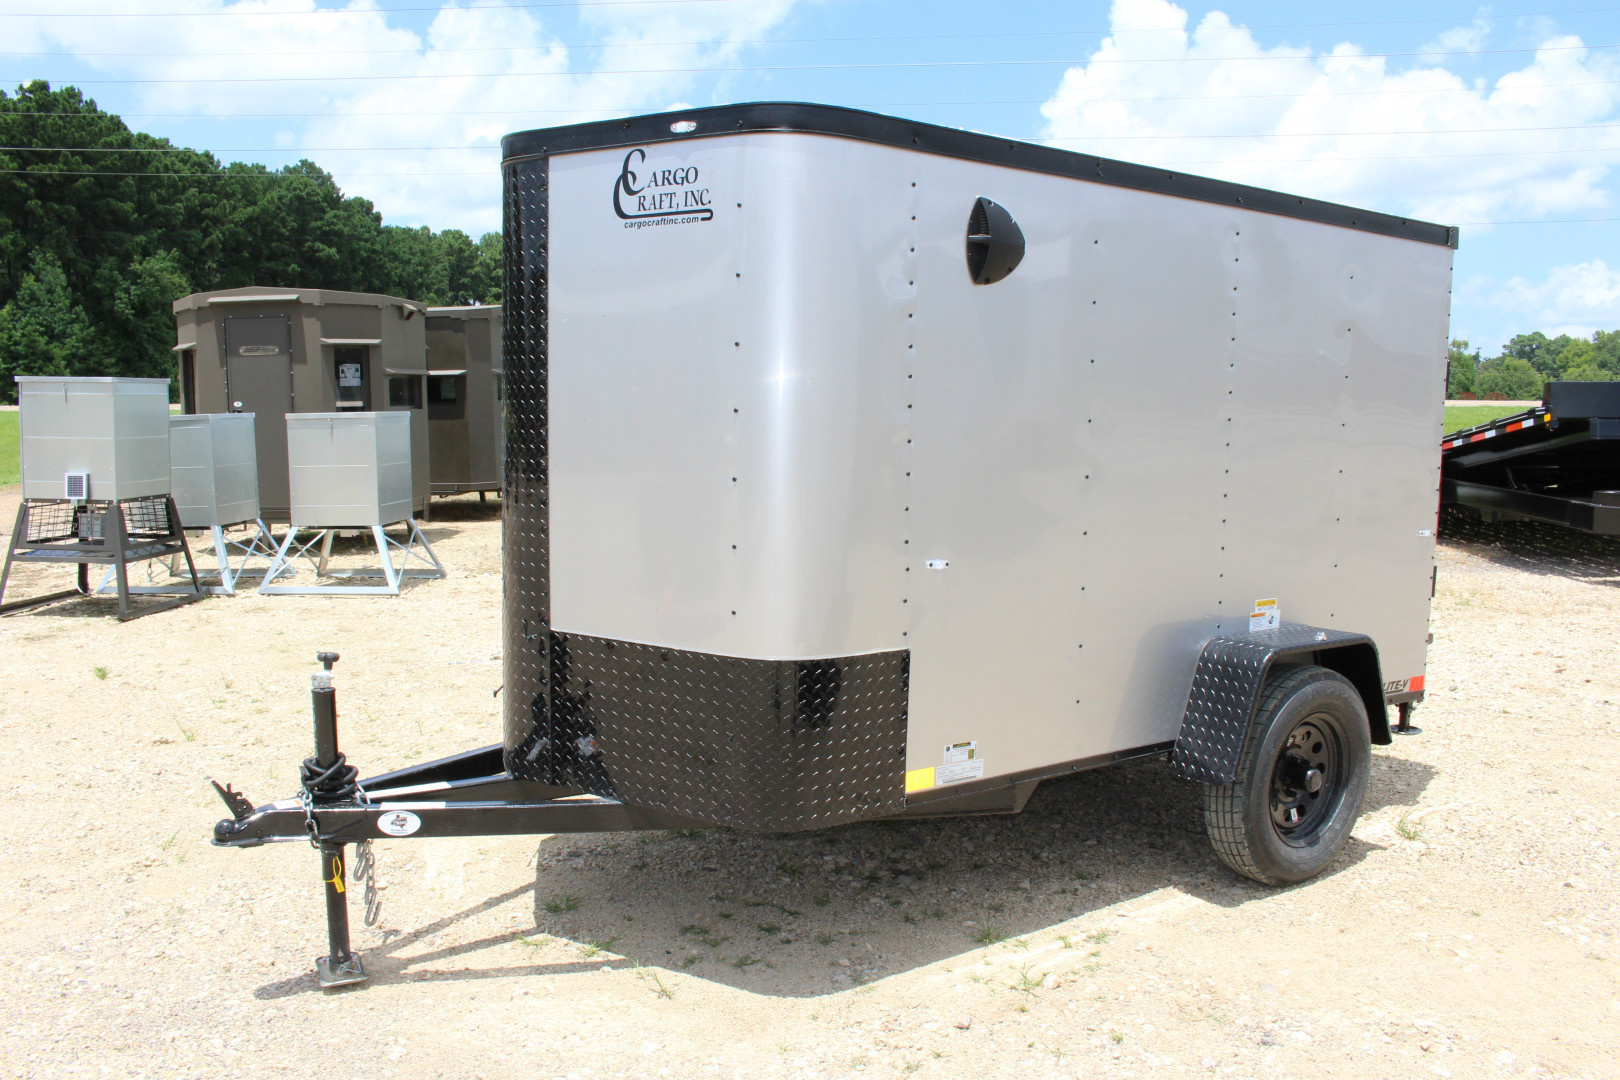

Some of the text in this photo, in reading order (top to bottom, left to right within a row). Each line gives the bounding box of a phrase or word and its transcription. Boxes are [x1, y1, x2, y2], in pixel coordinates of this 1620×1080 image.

[622, 148, 699, 196] CARGO
[684, 188, 712, 208] INC.
[624, 216, 700, 229] cargocraftinc.com
